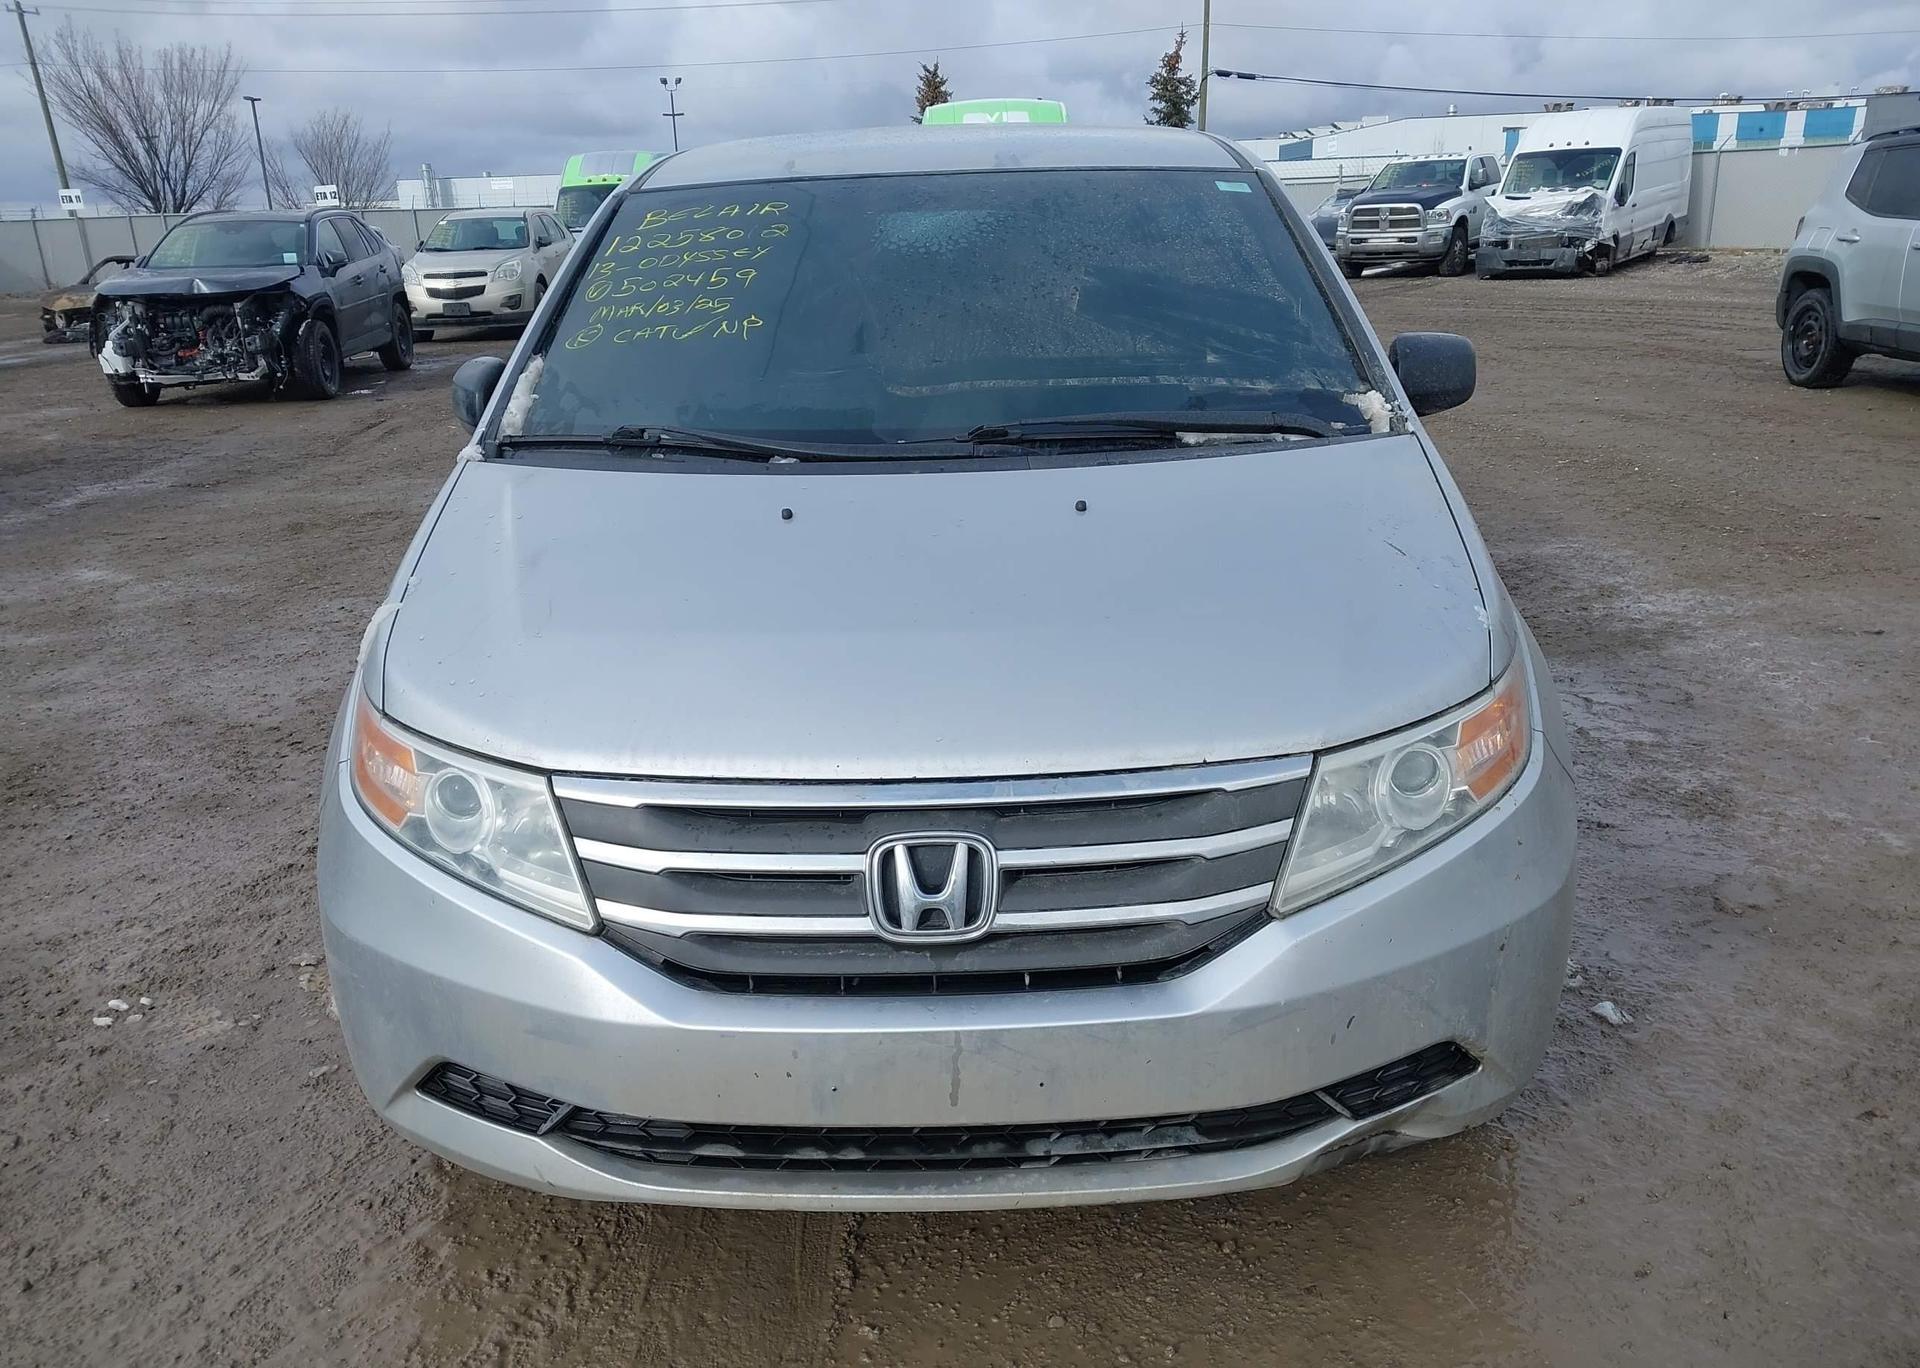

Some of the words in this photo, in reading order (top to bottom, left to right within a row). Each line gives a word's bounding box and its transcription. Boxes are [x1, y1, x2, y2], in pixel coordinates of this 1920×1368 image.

[60, 194, 74, 205] ETA
[316, 191, 328, 201] ETA
[329, 190, 338, 200] 12
